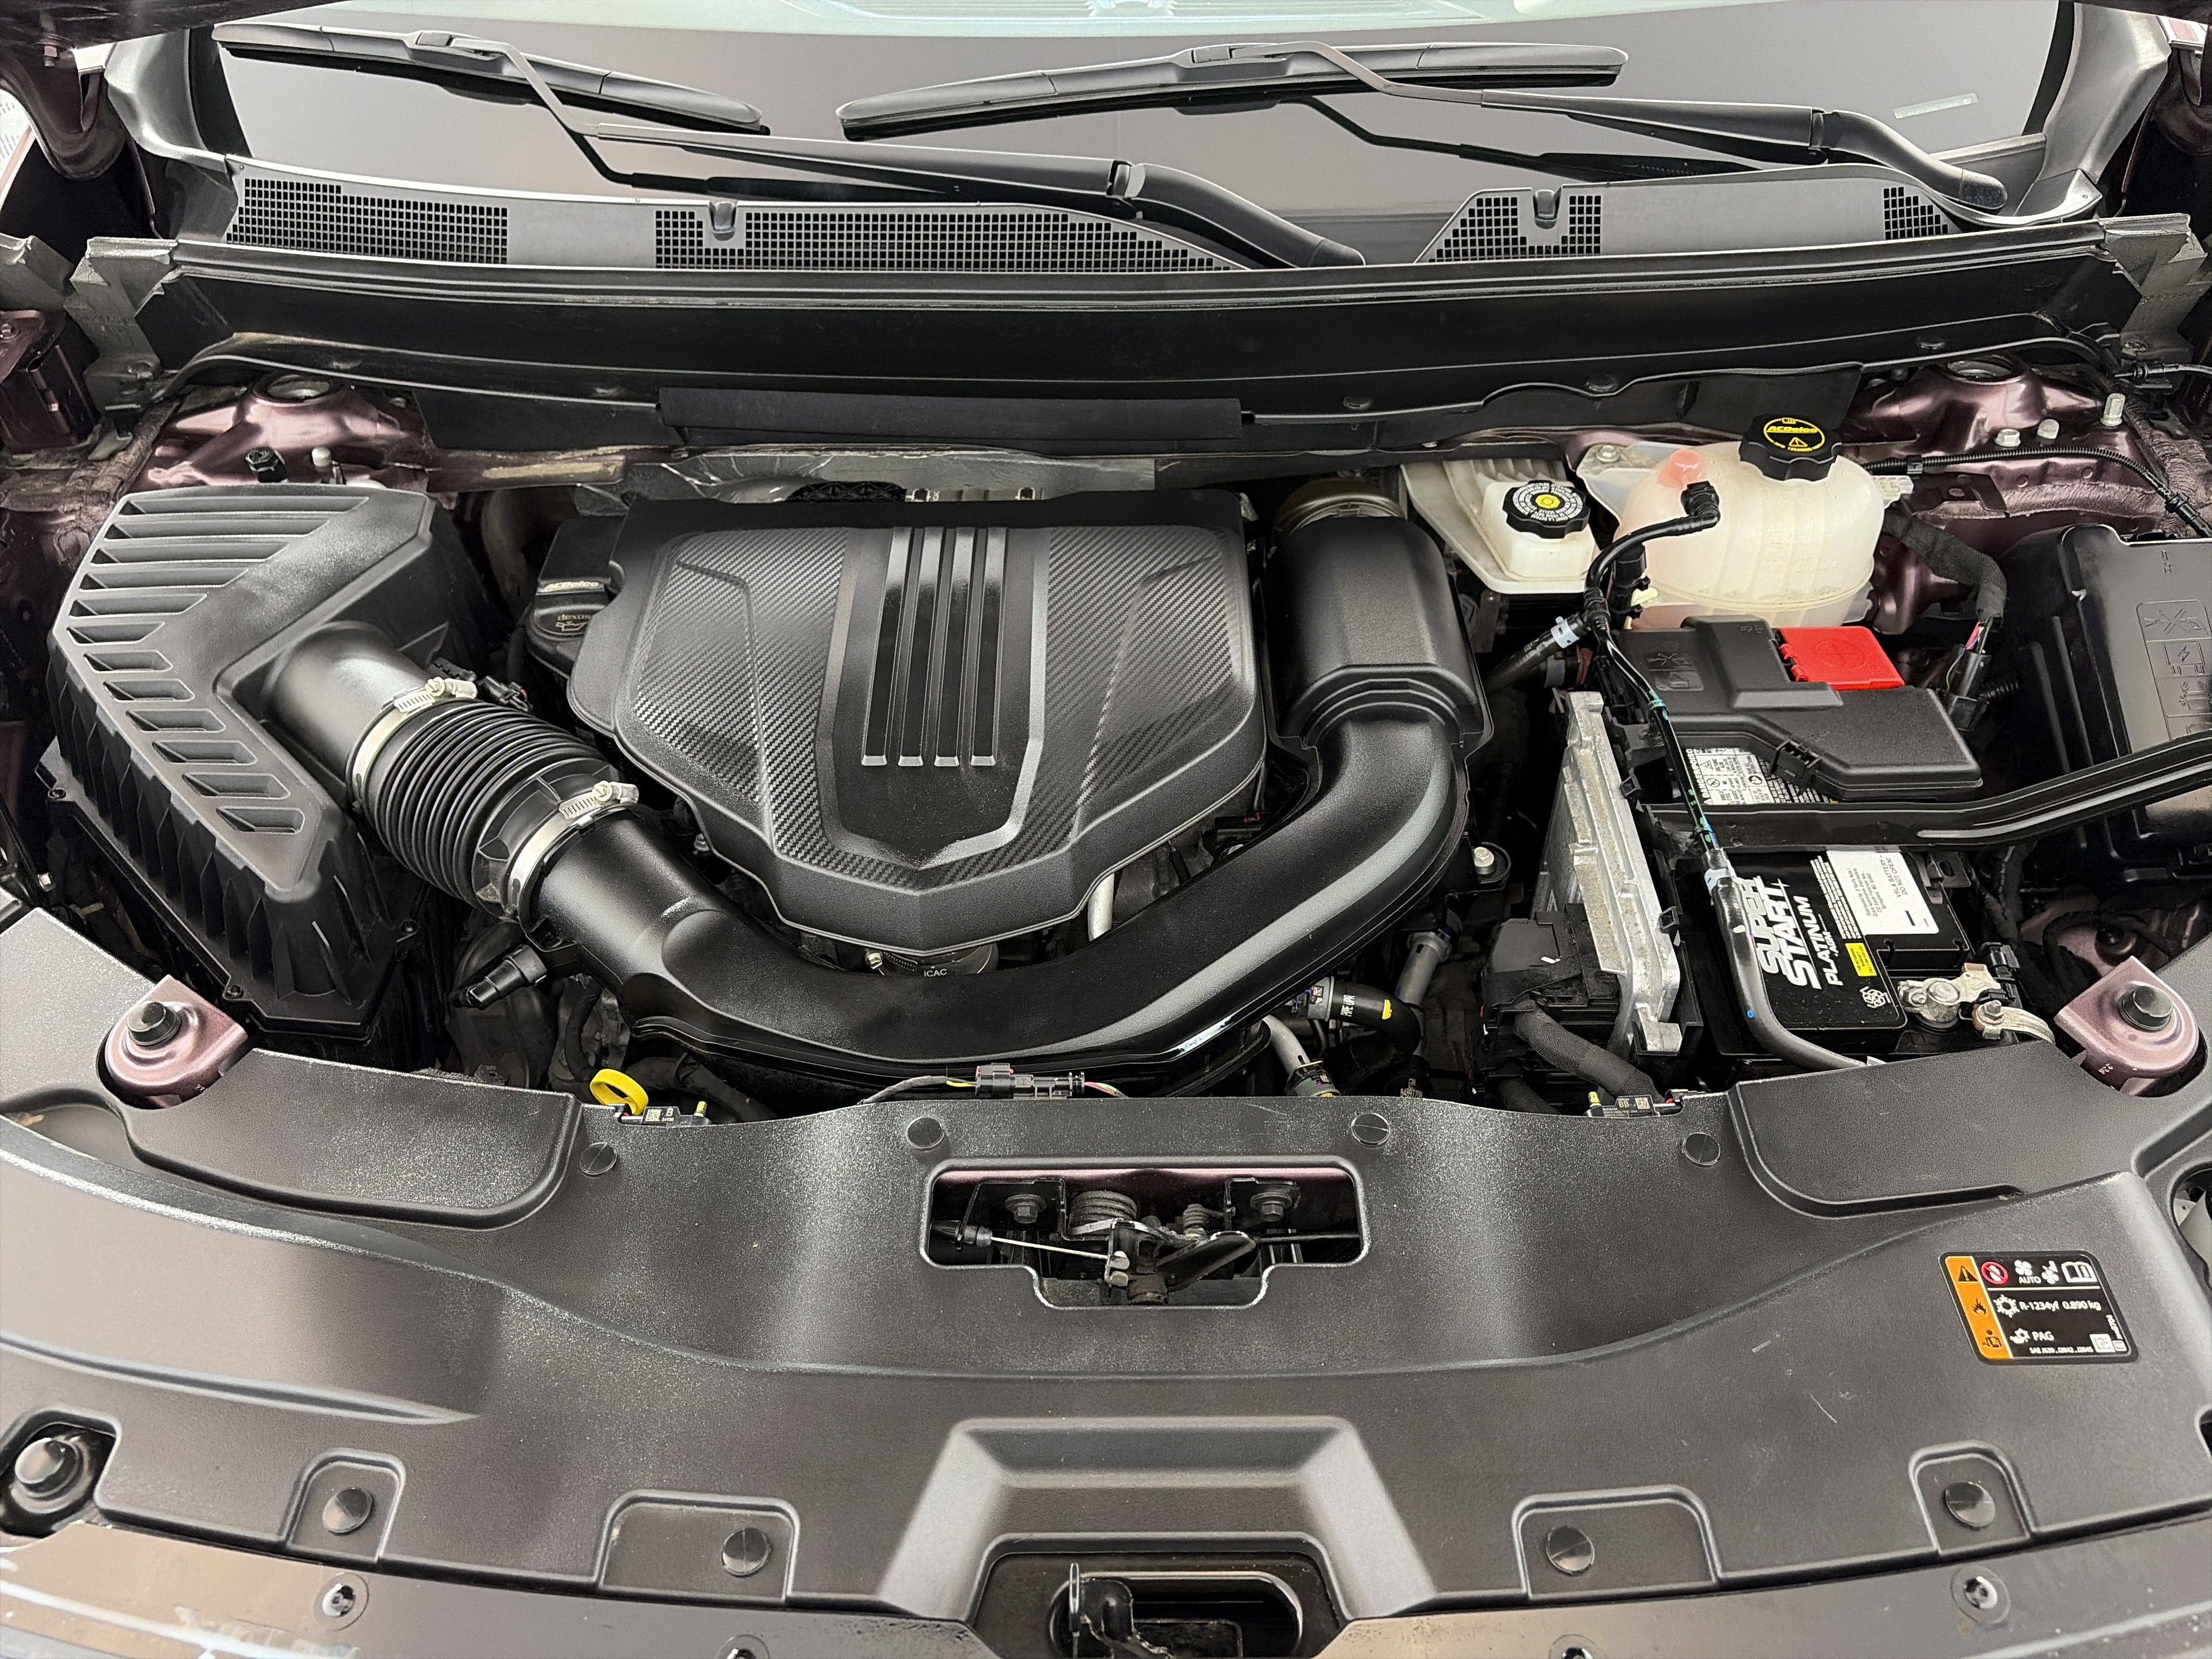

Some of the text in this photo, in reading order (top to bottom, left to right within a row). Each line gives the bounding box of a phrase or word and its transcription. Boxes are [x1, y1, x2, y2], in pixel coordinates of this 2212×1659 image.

[1767, 425, 1818, 433] ACDelco
[539, 580, 600, 592] ACDelco
[1685, 748, 1710, 798] DANGER/POISO
[1880, 859, 1894, 882] BATTERY
[1885, 857, 1908, 895] DO NOT OPEN!
[1891, 884, 1902, 898] VRLA
[1739, 877, 1789, 975] SUPER
[1753, 877, 1822, 990] START
[1793, 896, 1843, 986] PLATINUM
[1821, 931, 1839, 953] AGM
[924, 968, 947, 977] ICAC
[666, 1108, 674, 1117] B
[2019, 1276, 2041, 1284] AUTO
[2019, 1300, 2101, 1311] R-1234yf 0.890 kg
[2032, 1330, 2055, 1341] PAG
